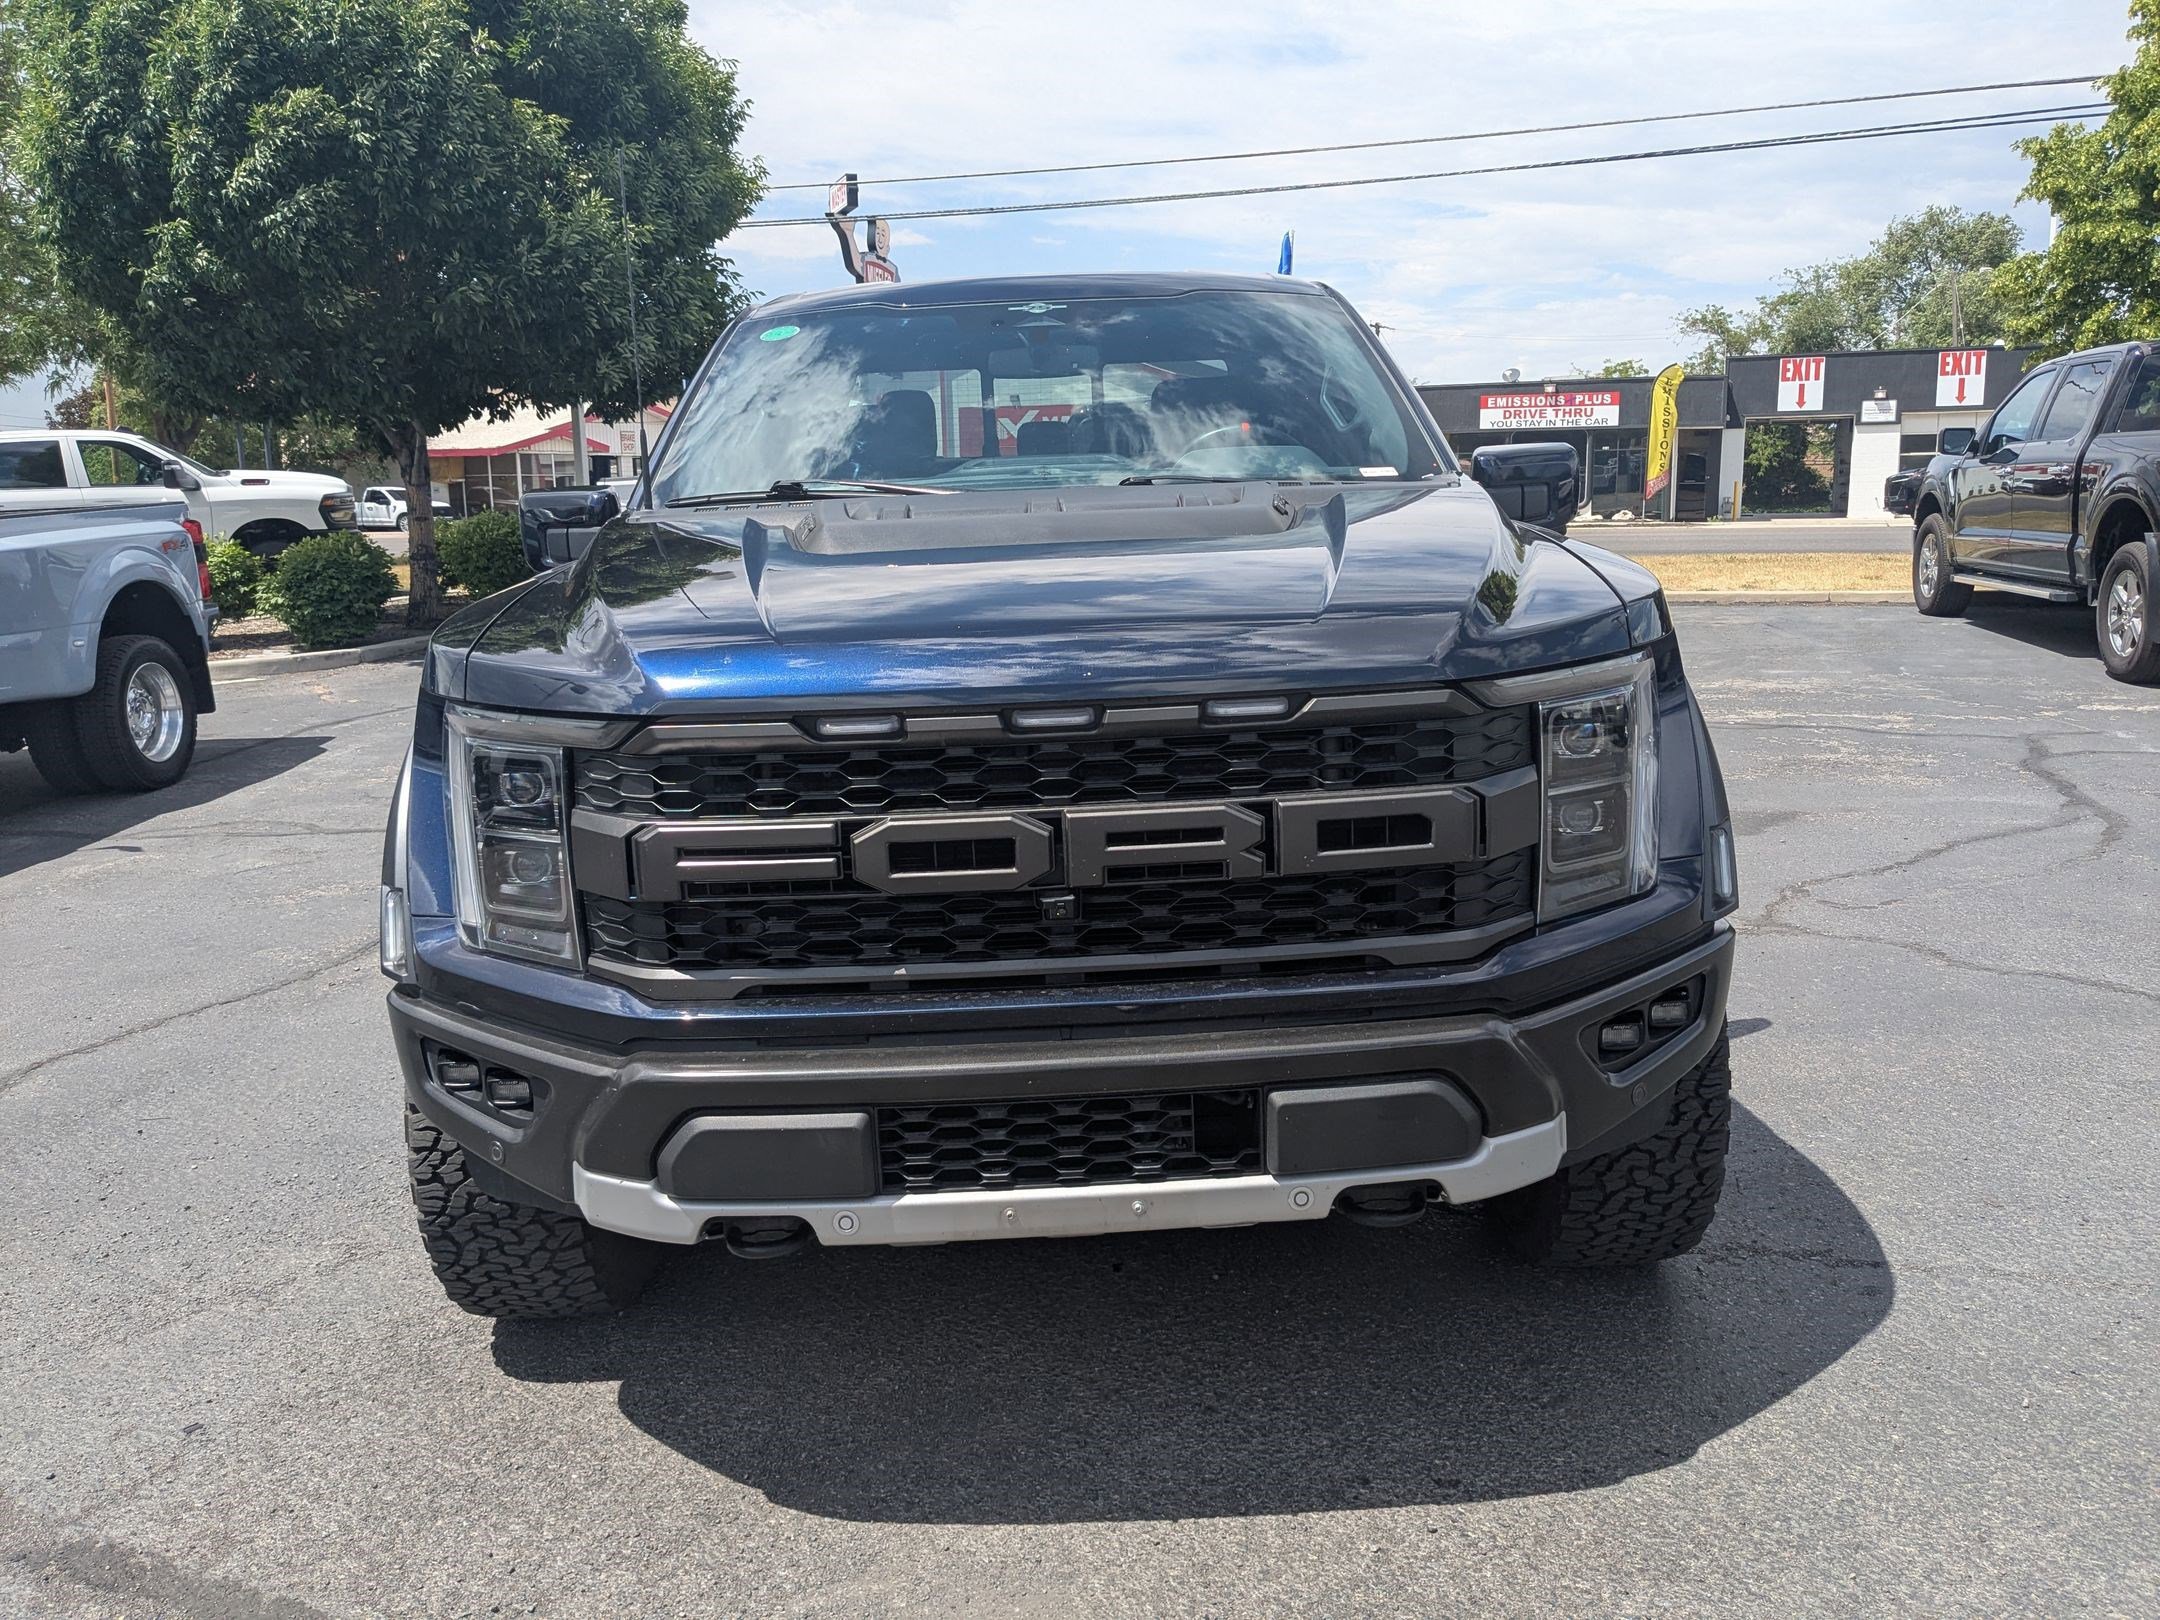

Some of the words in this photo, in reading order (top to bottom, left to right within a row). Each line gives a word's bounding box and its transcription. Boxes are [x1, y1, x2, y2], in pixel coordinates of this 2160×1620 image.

[1780, 358, 1824, 382] EXIT
[1938, 351, 1986, 376] EXIT
[1487, 395, 1565, 408] EMISSIONS
[1575, 393, 1612, 405] PLUS
[1489, 420, 1513, 428] YOU
[1515, 419, 1542, 427] STAY
[1545, 419, 1557, 427] IN
[1559, 418, 1582, 426] THE
[1584, 417, 1609, 426] CAR
[1502, 409, 1548, 420] DRIVE
[1552, 407, 1594, 418] THRU
[1659, 377, 1674, 472] EMISSIONS
[630, 787, 1478, 902] FORD
